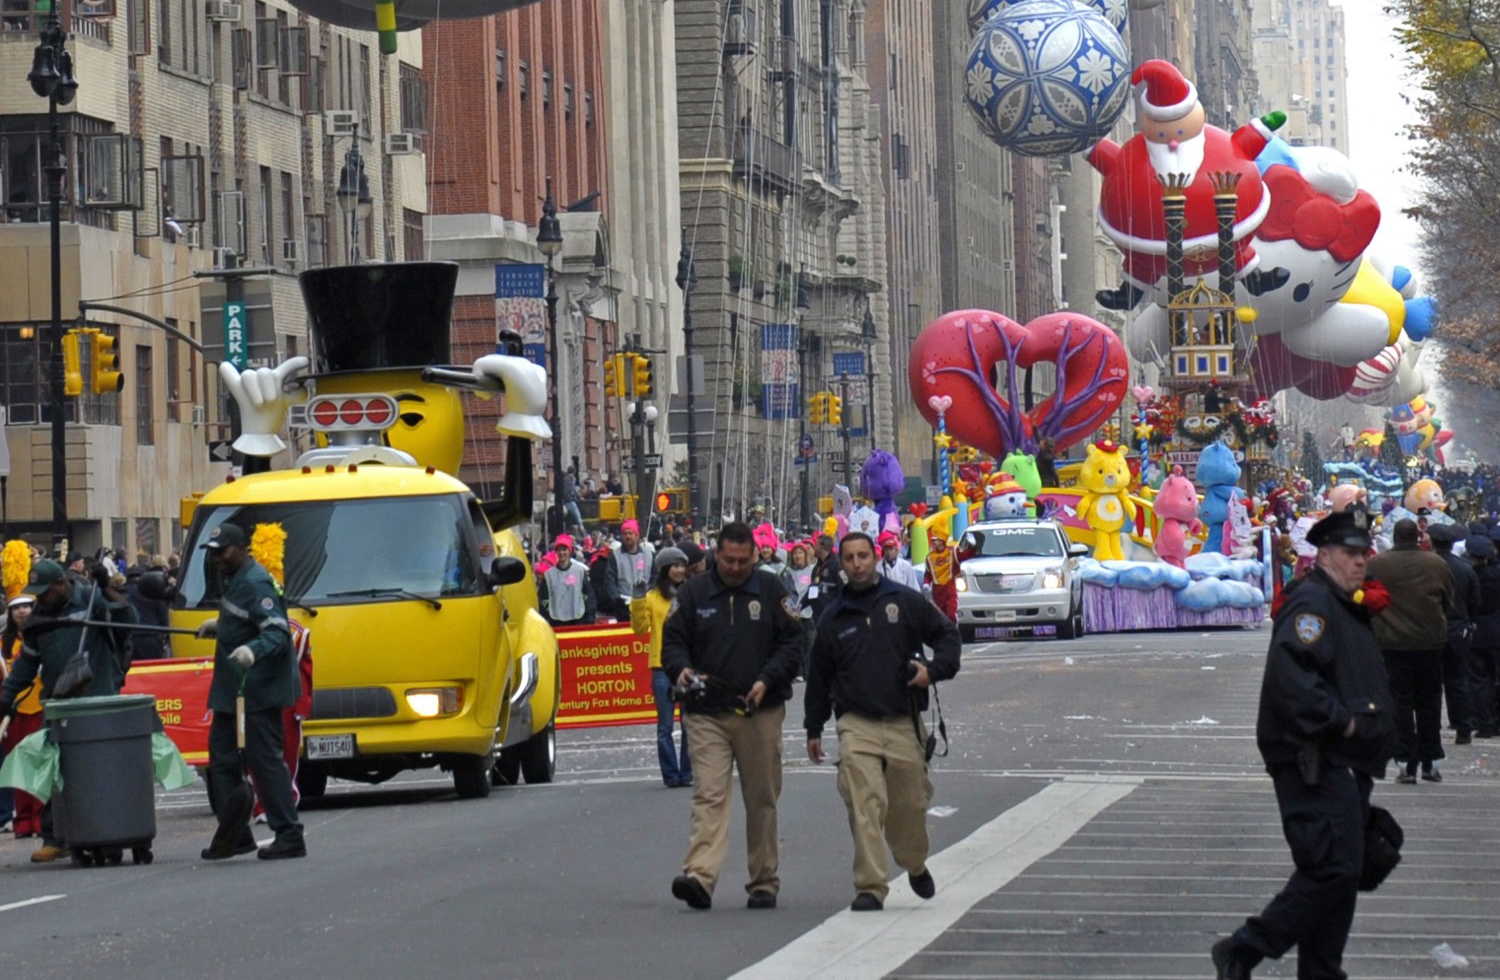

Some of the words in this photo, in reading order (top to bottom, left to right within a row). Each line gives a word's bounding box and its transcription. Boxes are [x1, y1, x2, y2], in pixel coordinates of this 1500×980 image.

[228, 305, 242, 353] PARK
[993, 528, 1035, 536] GMC
[577, 661, 633, 678] presents
[577, 679, 636, 695] HORTON
[592, 698, 610, 707] Fox
[612, 697, 642, 706] Home
